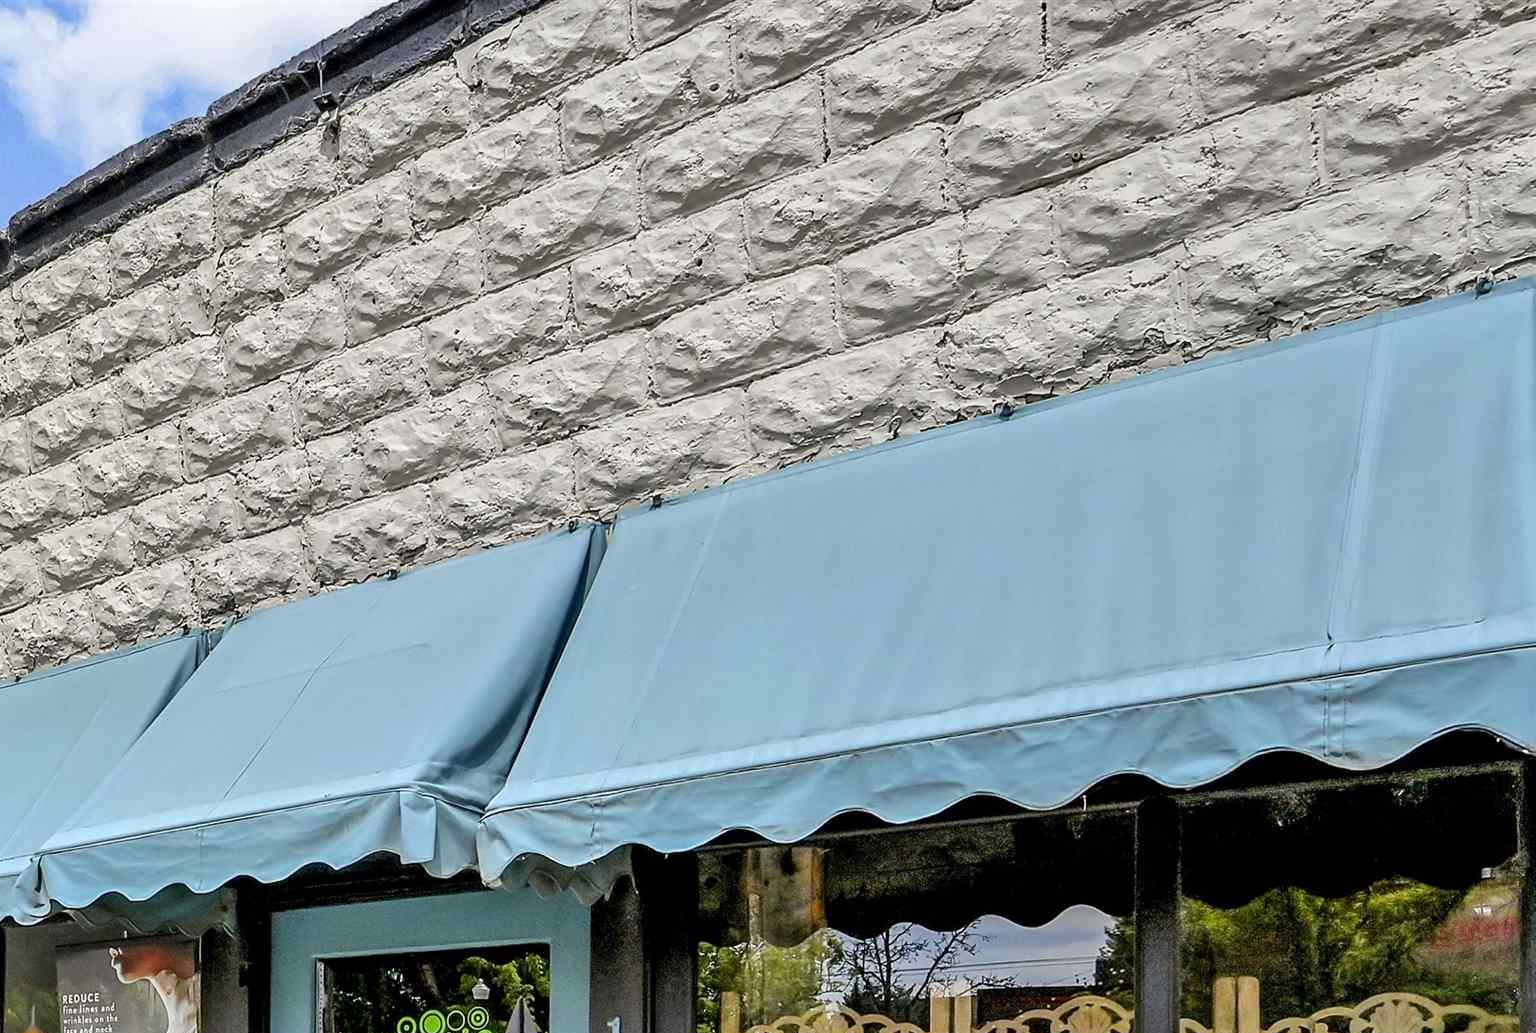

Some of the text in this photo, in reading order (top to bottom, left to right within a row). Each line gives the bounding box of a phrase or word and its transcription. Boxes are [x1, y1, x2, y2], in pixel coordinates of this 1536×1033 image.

[62, 993, 100, 1004] REDUCE
[79, 1004, 98, 1013] lines
[101, 1002, 115, 1012] and
[106, 1013, 118, 1022] the
[79, 1025, 93, 1033] and
[95, 1024, 113, 1033] neck
